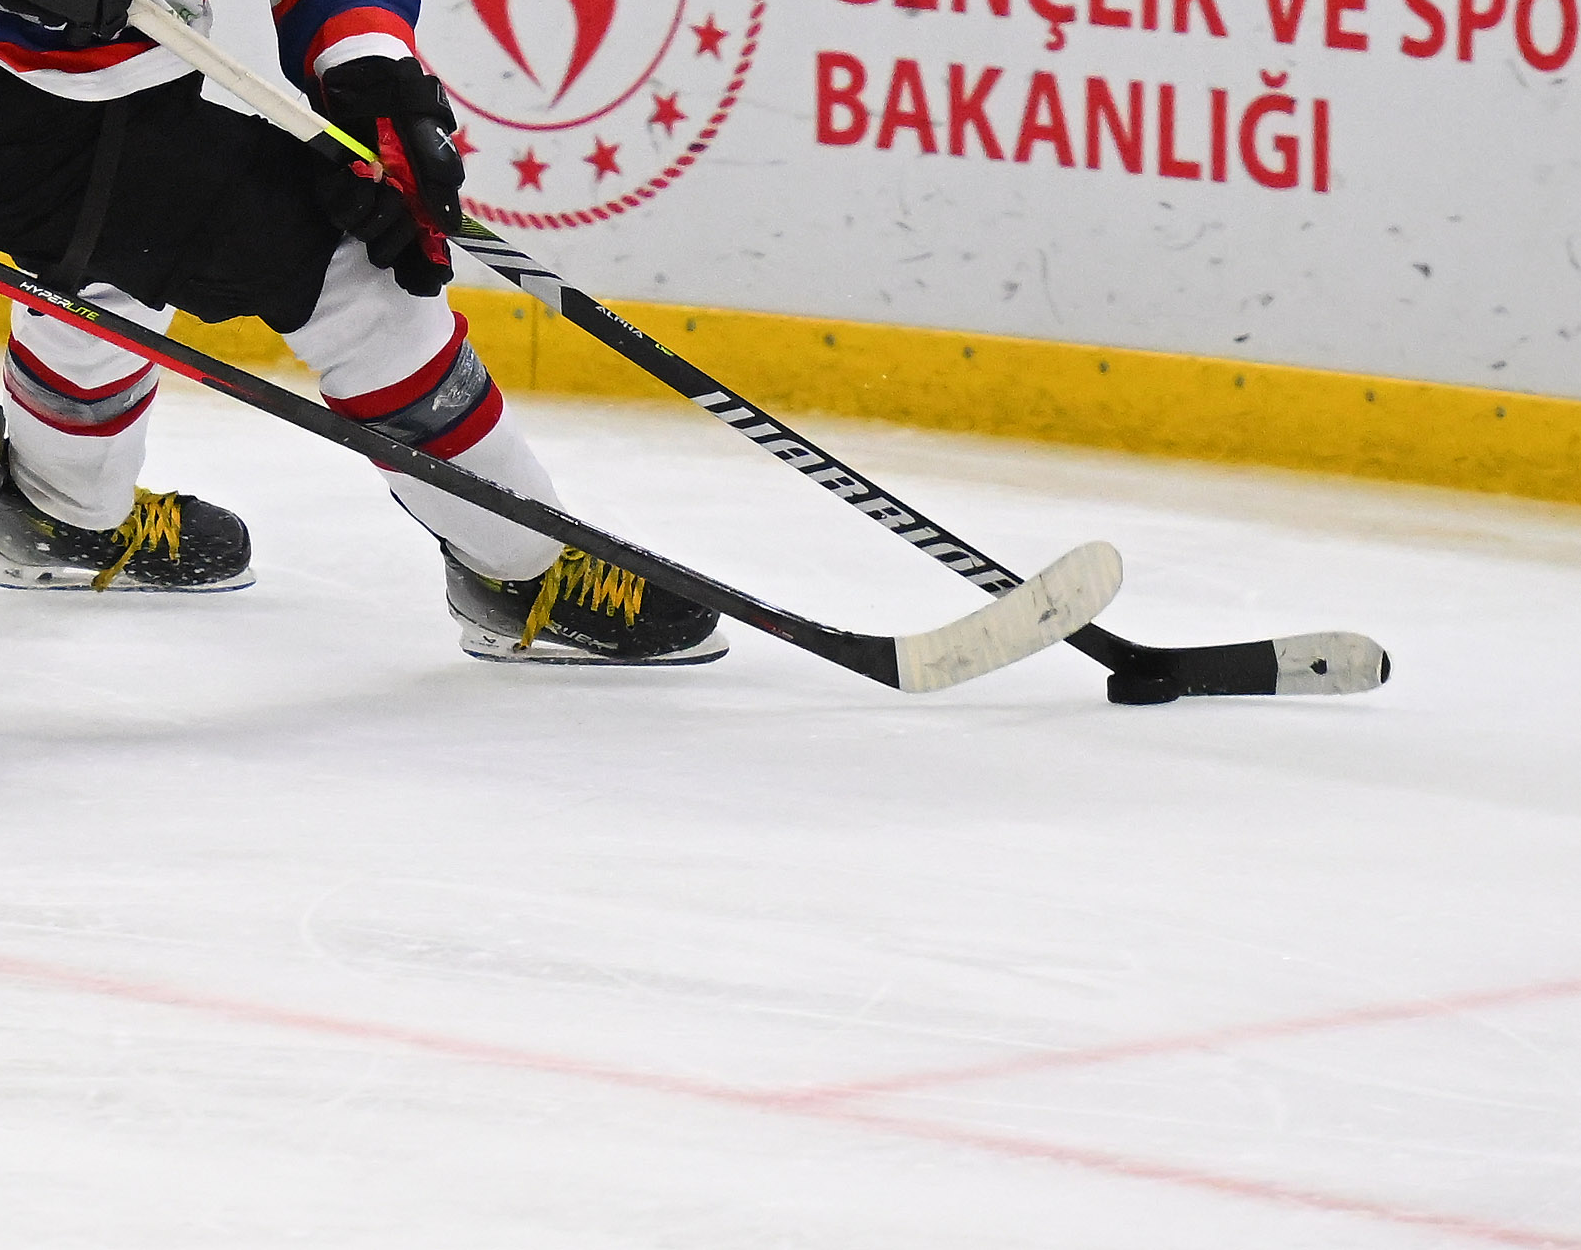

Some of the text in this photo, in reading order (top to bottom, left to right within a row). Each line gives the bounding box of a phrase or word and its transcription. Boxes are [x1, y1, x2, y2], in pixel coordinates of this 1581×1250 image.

[815, 50, 1332, 193] BAKANLIĞI
[19, 281, 100, 322] HYPERLITE
[594, 305, 644, 339] ALPHA
